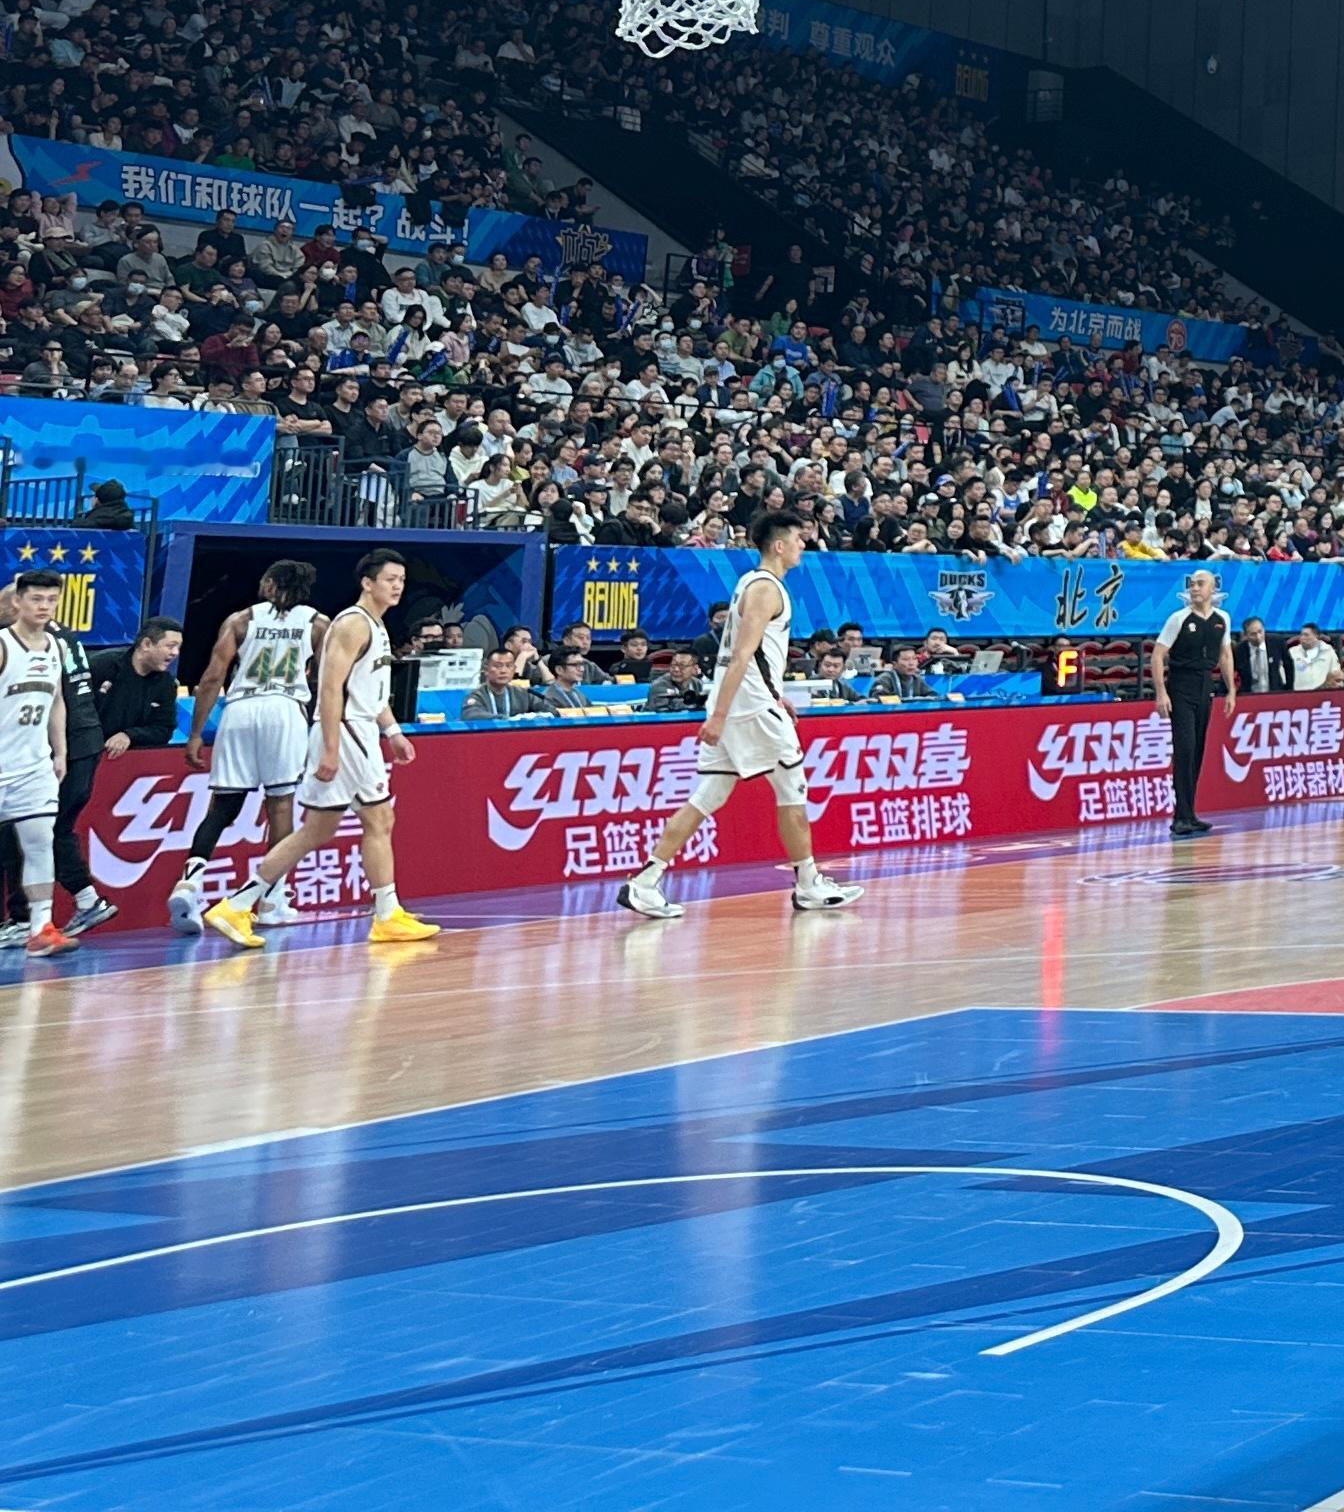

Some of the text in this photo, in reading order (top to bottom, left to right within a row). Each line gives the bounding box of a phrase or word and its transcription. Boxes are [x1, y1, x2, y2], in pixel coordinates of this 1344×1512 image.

[809, 19, 896, 68] 尊重观众
[1049, 306, 1142, 342] 为北京而战
[939, 570, 986, 589] DUCKS
[1055, 564, 1125, 629] 北京
[583, 580, 640, 631] BEIJING
[246, 646, 300, 685] 44
[1058, 650, 1079, 688] F
[18, 704, 45, 726] 33
[1027, 712, 1174, 802] 红双喜
[1222, 701, 1344, 784] 红双喜
[487, 734, 702, 852] 红双喜
[802, 723, 971, 822] 红双喜
[850, 792, 972, 846] 足篮排球
[1078, 774, 1177, 823] 足篮排球
